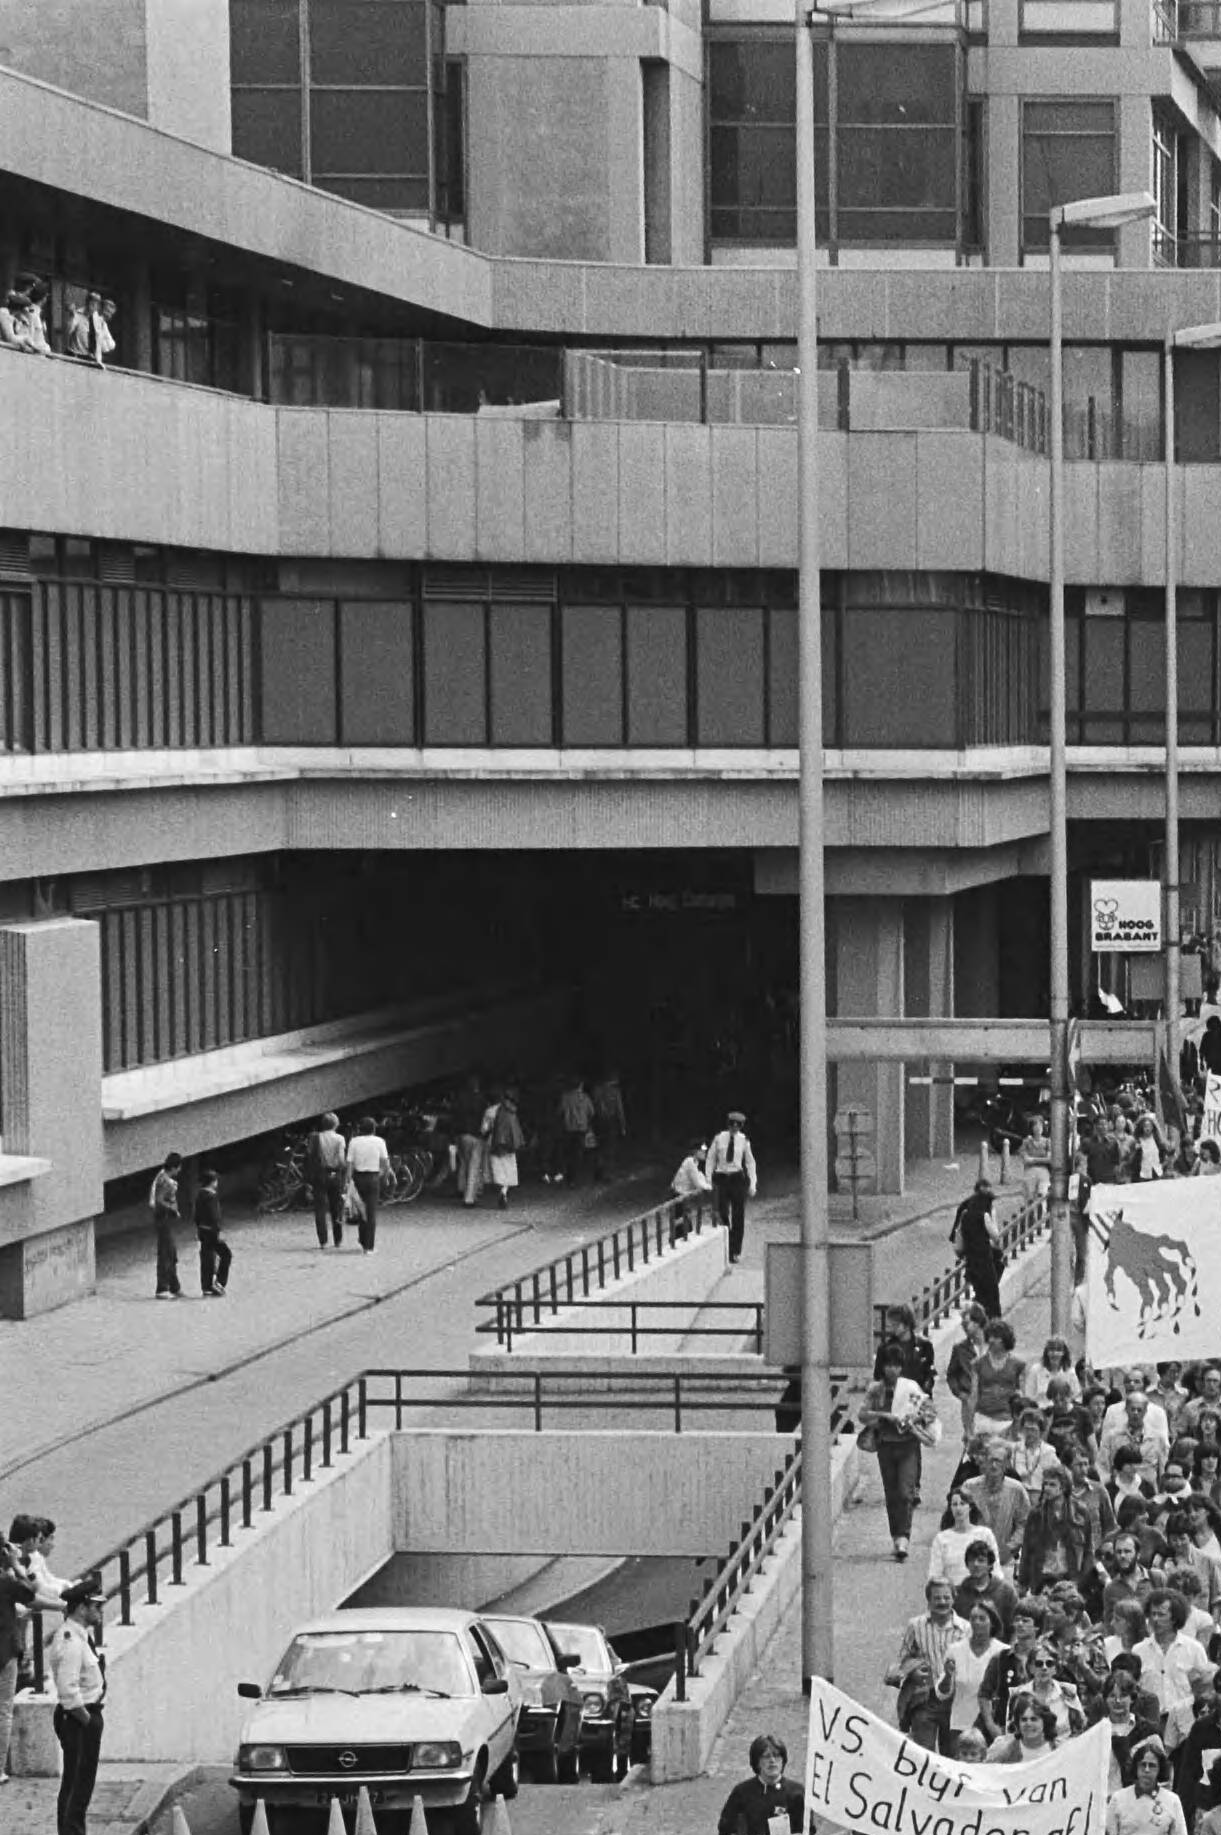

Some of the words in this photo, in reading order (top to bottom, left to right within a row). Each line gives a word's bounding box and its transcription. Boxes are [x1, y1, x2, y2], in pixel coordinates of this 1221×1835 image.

[1095, 932, 1158, 941] BRABANT
[1119, 920, 1154, 929] HOOG
[818, 1698, 869, 1757] V.S.
[1003, 1776, 1067, 1805] van
[811, 1752, 834, 1805] El
